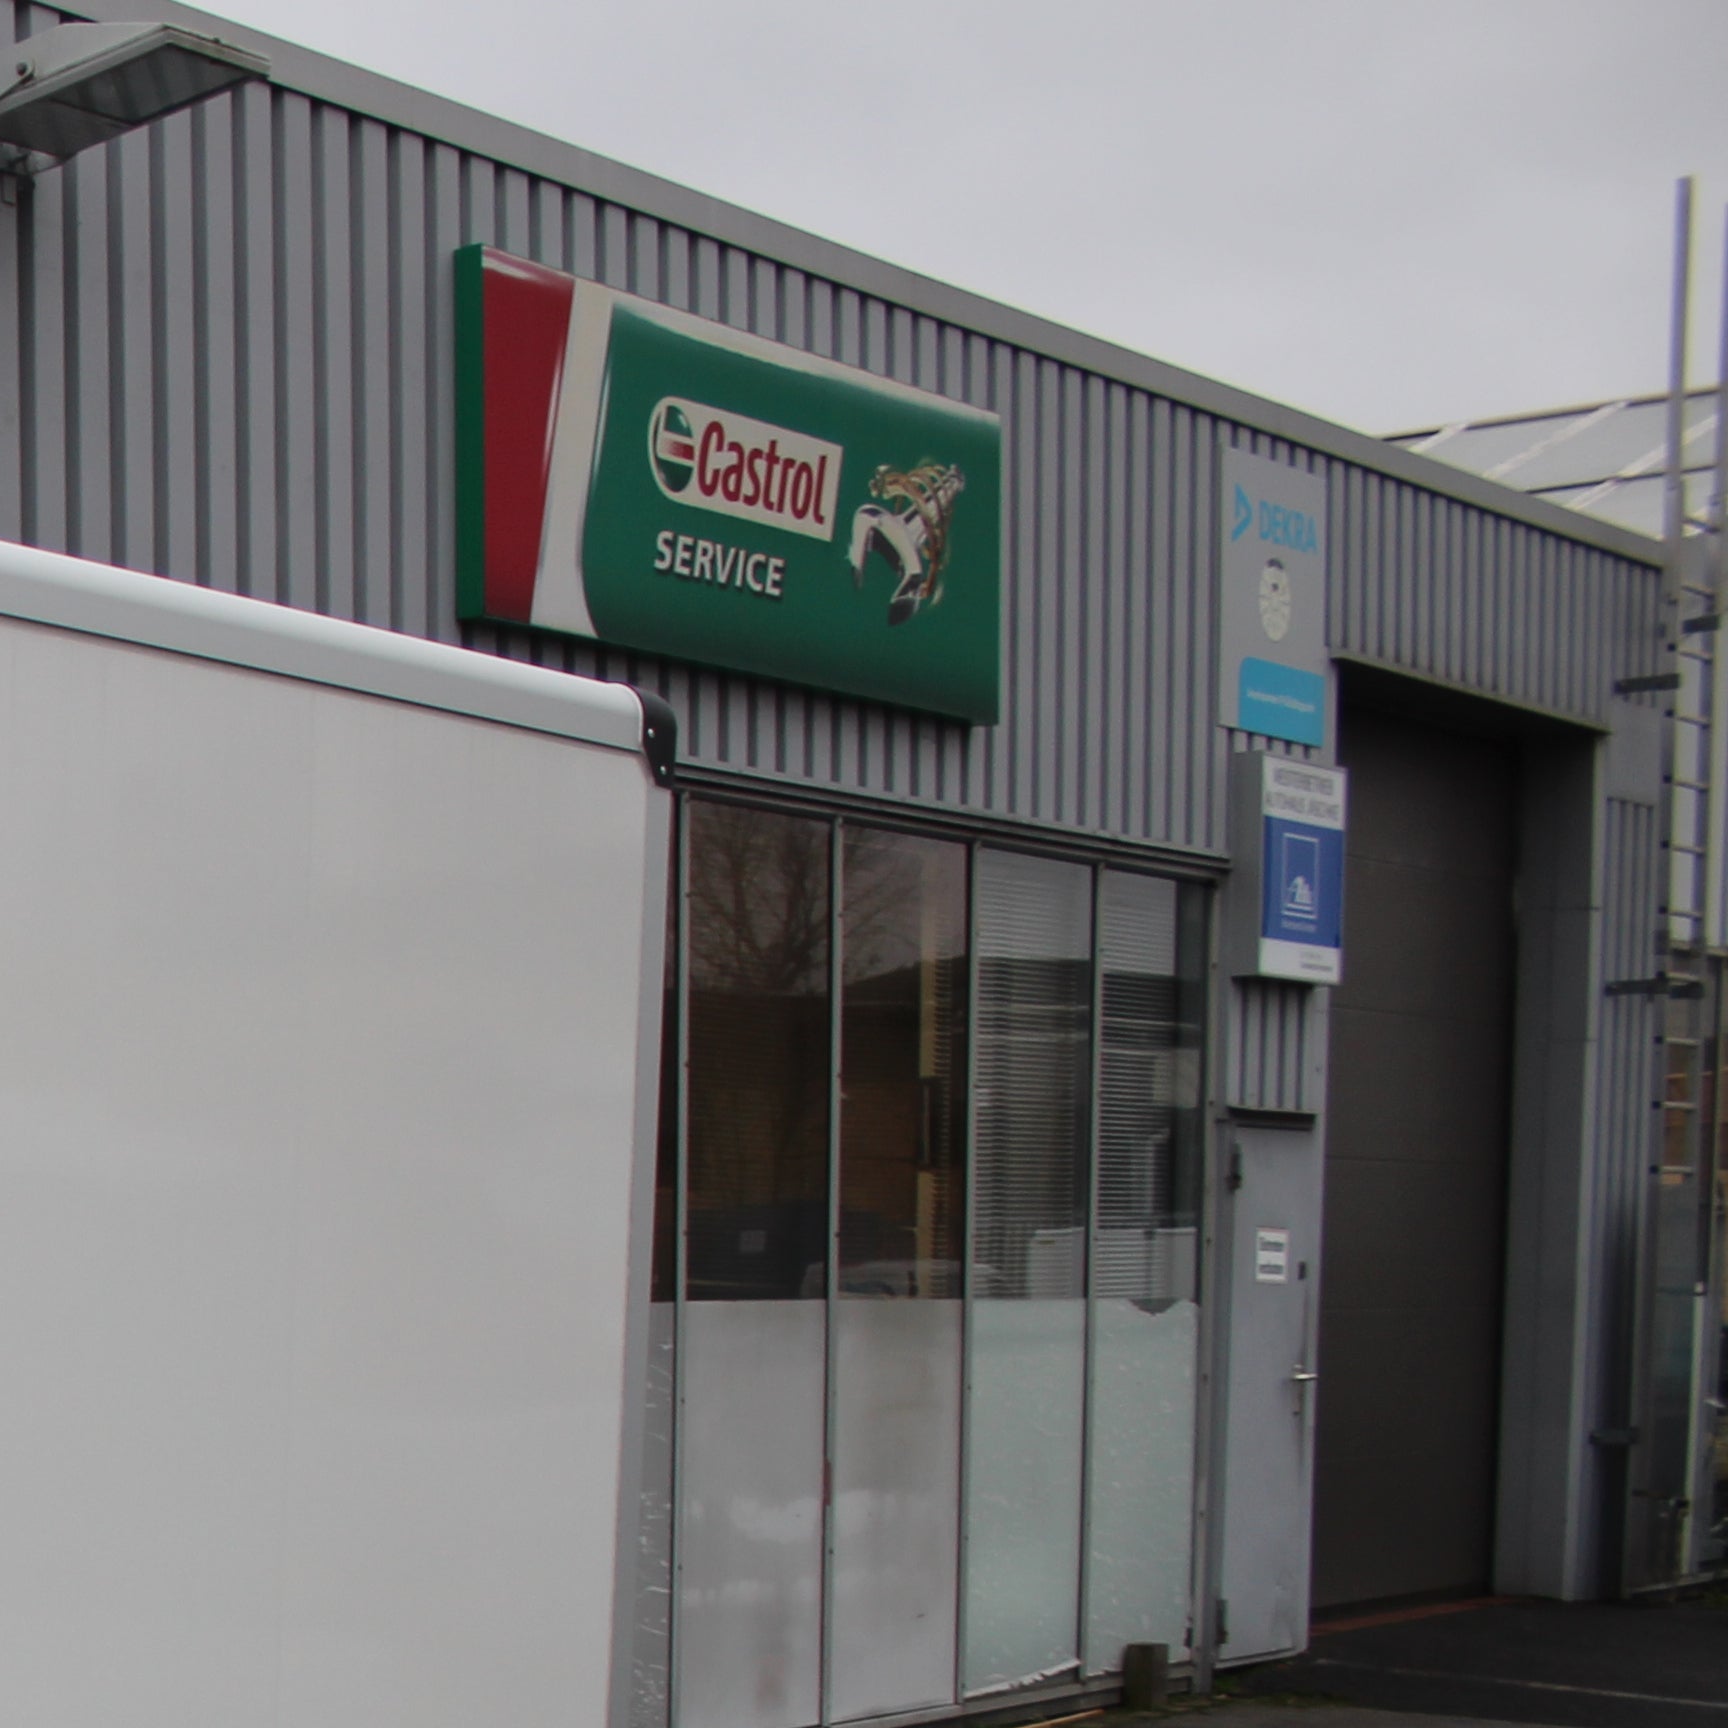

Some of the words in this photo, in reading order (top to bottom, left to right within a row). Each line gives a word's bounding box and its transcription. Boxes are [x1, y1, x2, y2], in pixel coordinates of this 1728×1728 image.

[698, 420, 827, 525] Castrol
[1258, 500, 1318, 553] DEKRA
[654, 530, 785, 597] SERVICE
